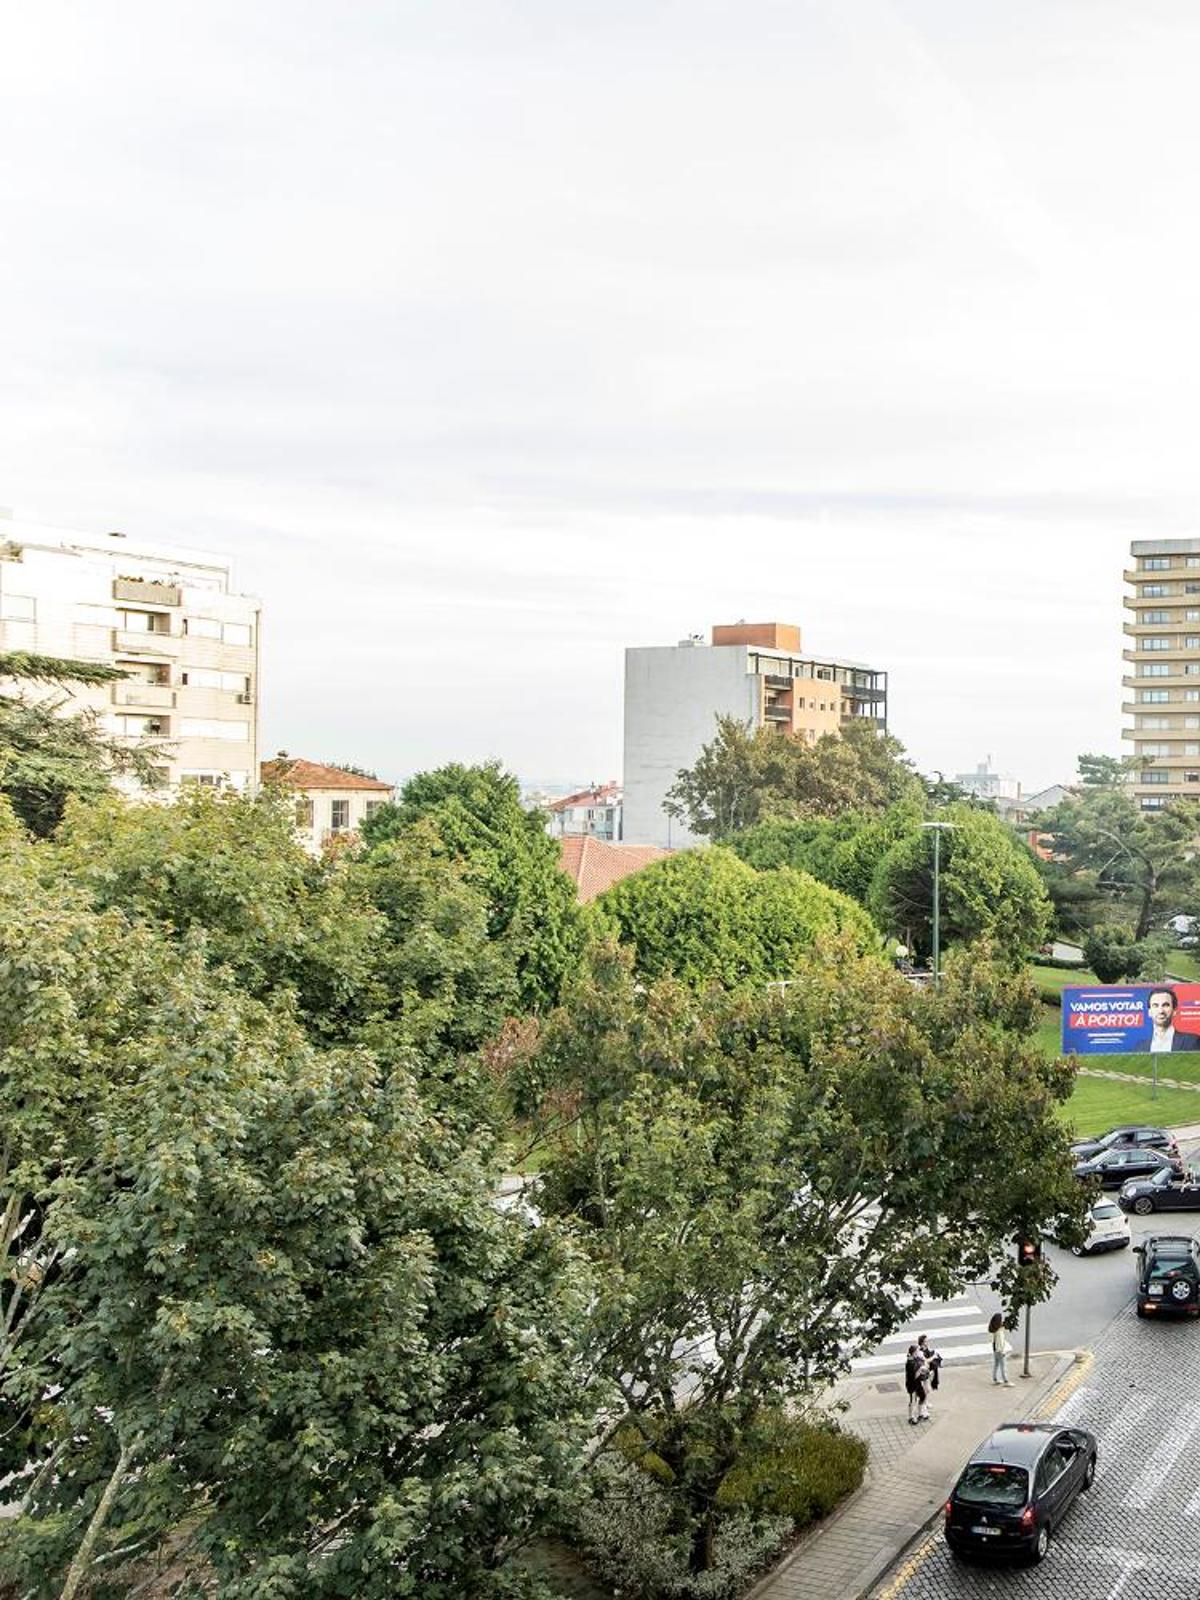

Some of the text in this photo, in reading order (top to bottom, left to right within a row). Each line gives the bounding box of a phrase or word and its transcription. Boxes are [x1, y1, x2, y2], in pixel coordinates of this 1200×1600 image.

[1070, 1001, 1144, 1011] VAMOS VOTAR
[1075, 1012, 1140, 1027] À PORTO!
